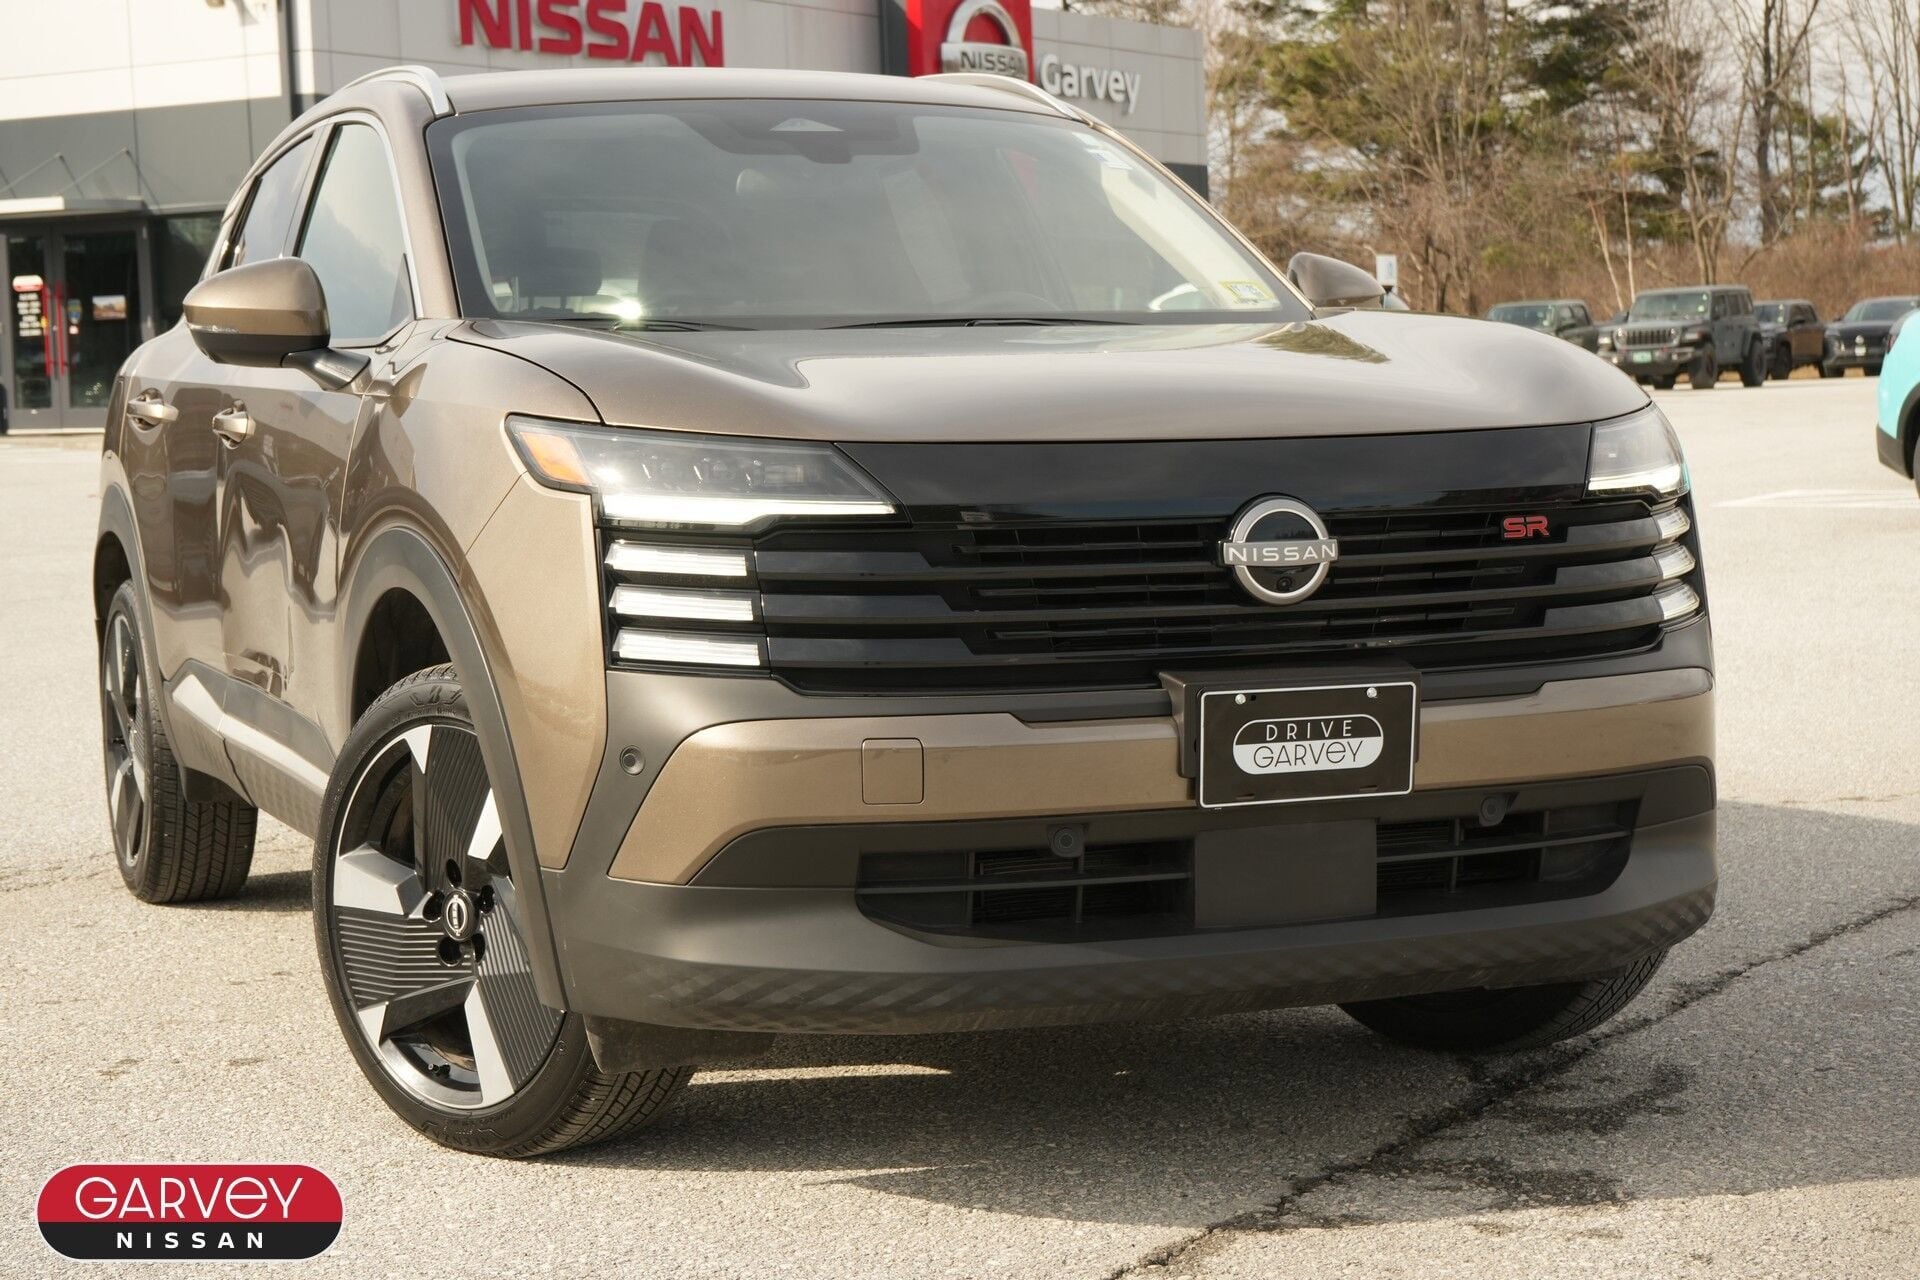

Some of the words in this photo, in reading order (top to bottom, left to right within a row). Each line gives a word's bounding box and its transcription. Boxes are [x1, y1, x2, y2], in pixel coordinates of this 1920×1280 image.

[458, 0, 724, 67] NISSAN
[1040, 53, 1140, 114] Garvey
[1503, 516, 1549, 538] SR
[1228, 543, 1336, 562] NISSAN
[1266, 720, 1352, 741] DRIVE
